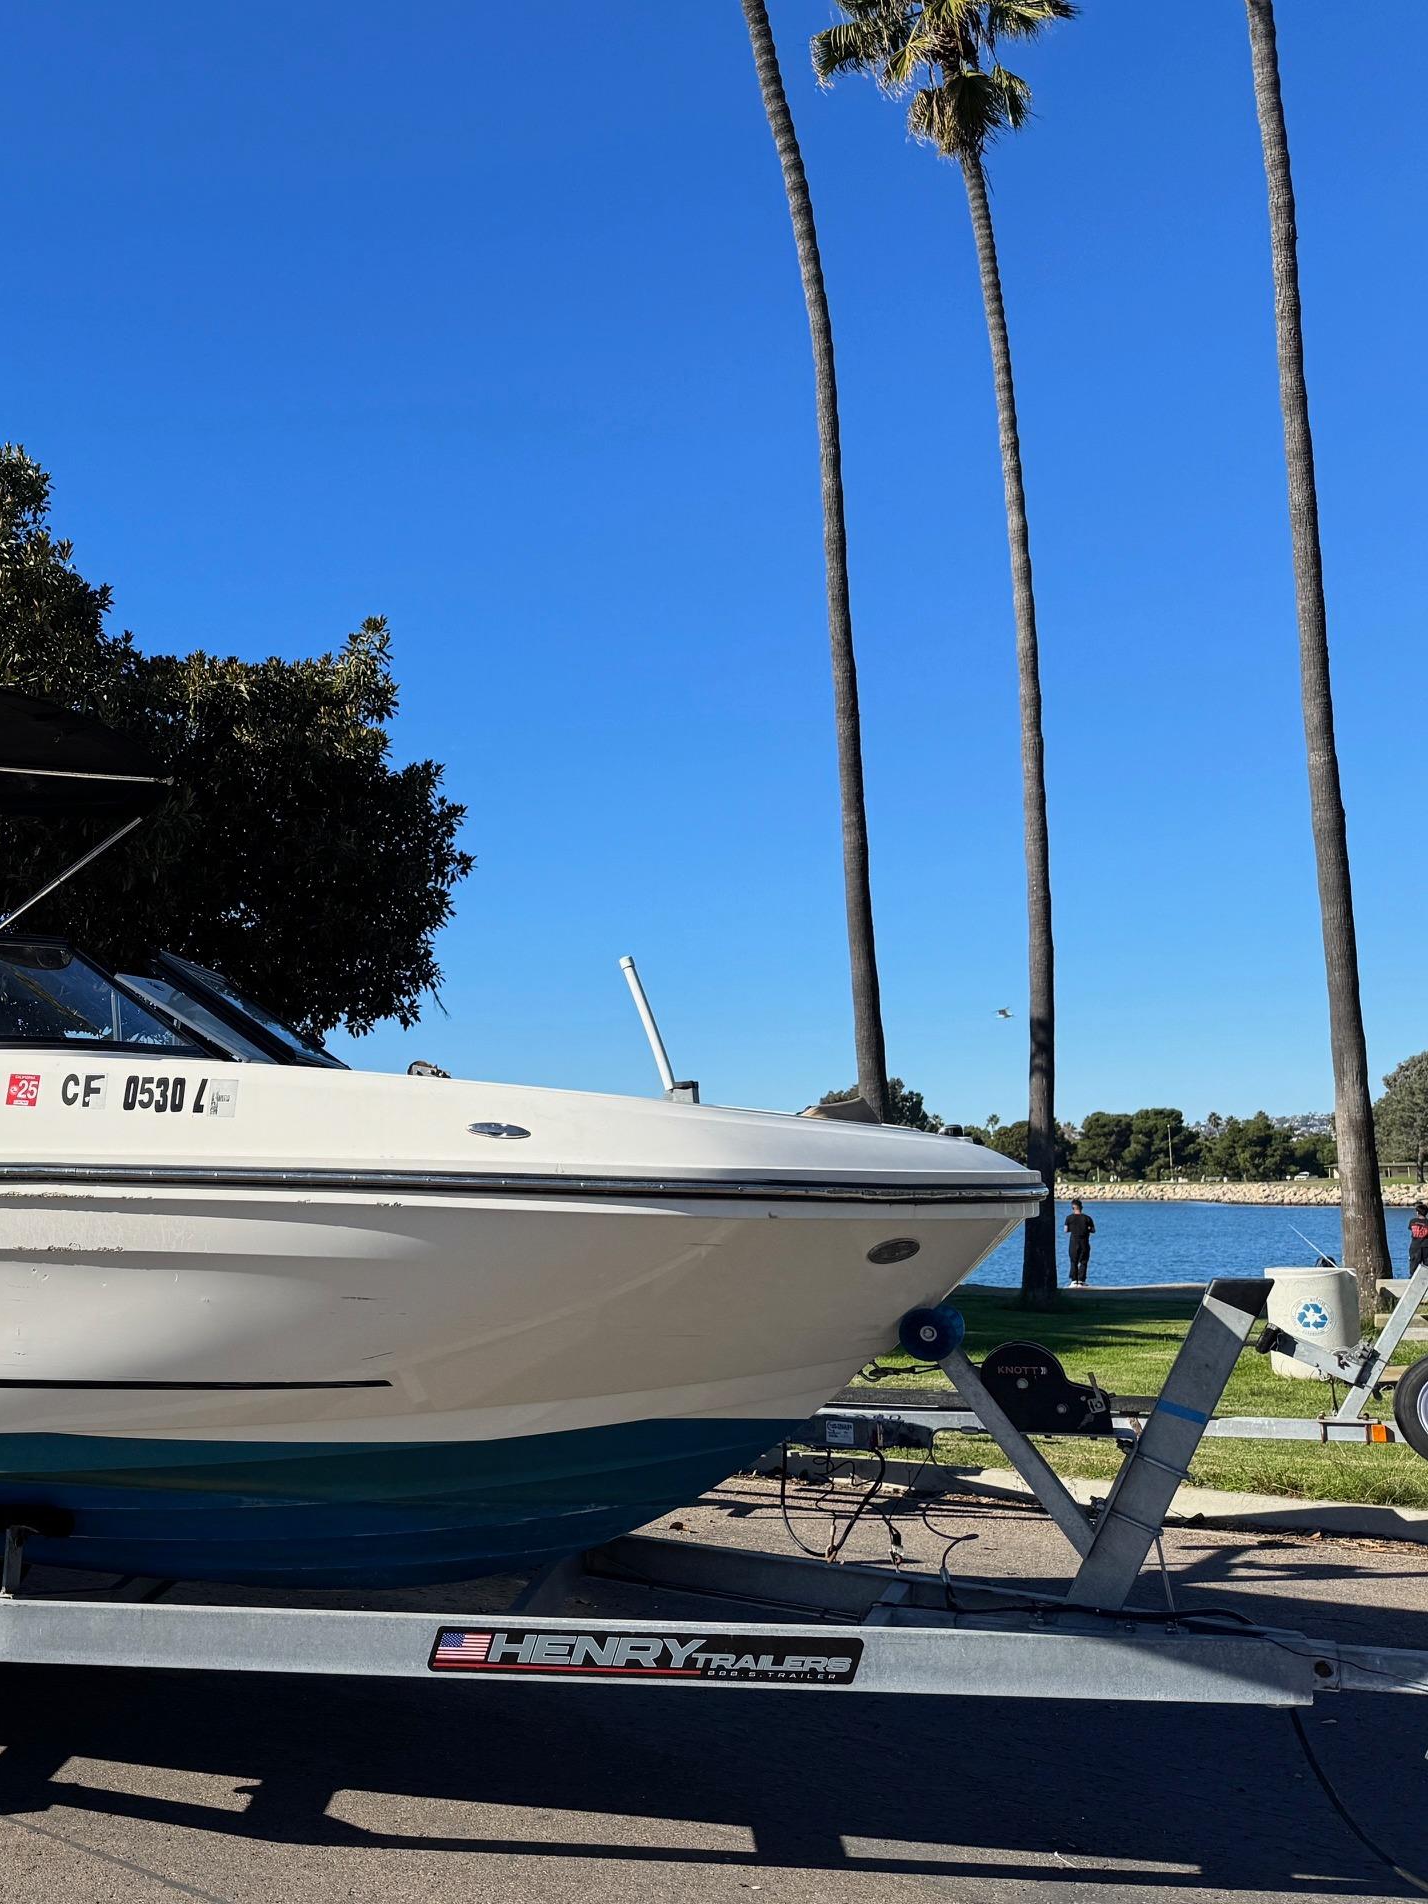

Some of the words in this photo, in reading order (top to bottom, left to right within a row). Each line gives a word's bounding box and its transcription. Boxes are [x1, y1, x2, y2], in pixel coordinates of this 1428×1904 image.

[17, 1080, 39, 1099] 25
[62, 1073, 105, 1107] CF
[123, 1075, 186, 1112] 0530
[997, 1366, 1039, 1375] KNOTT
[487, 1633, 707, 1668] HENRY
[691, 1653, 852, 1672] TRAILERS
